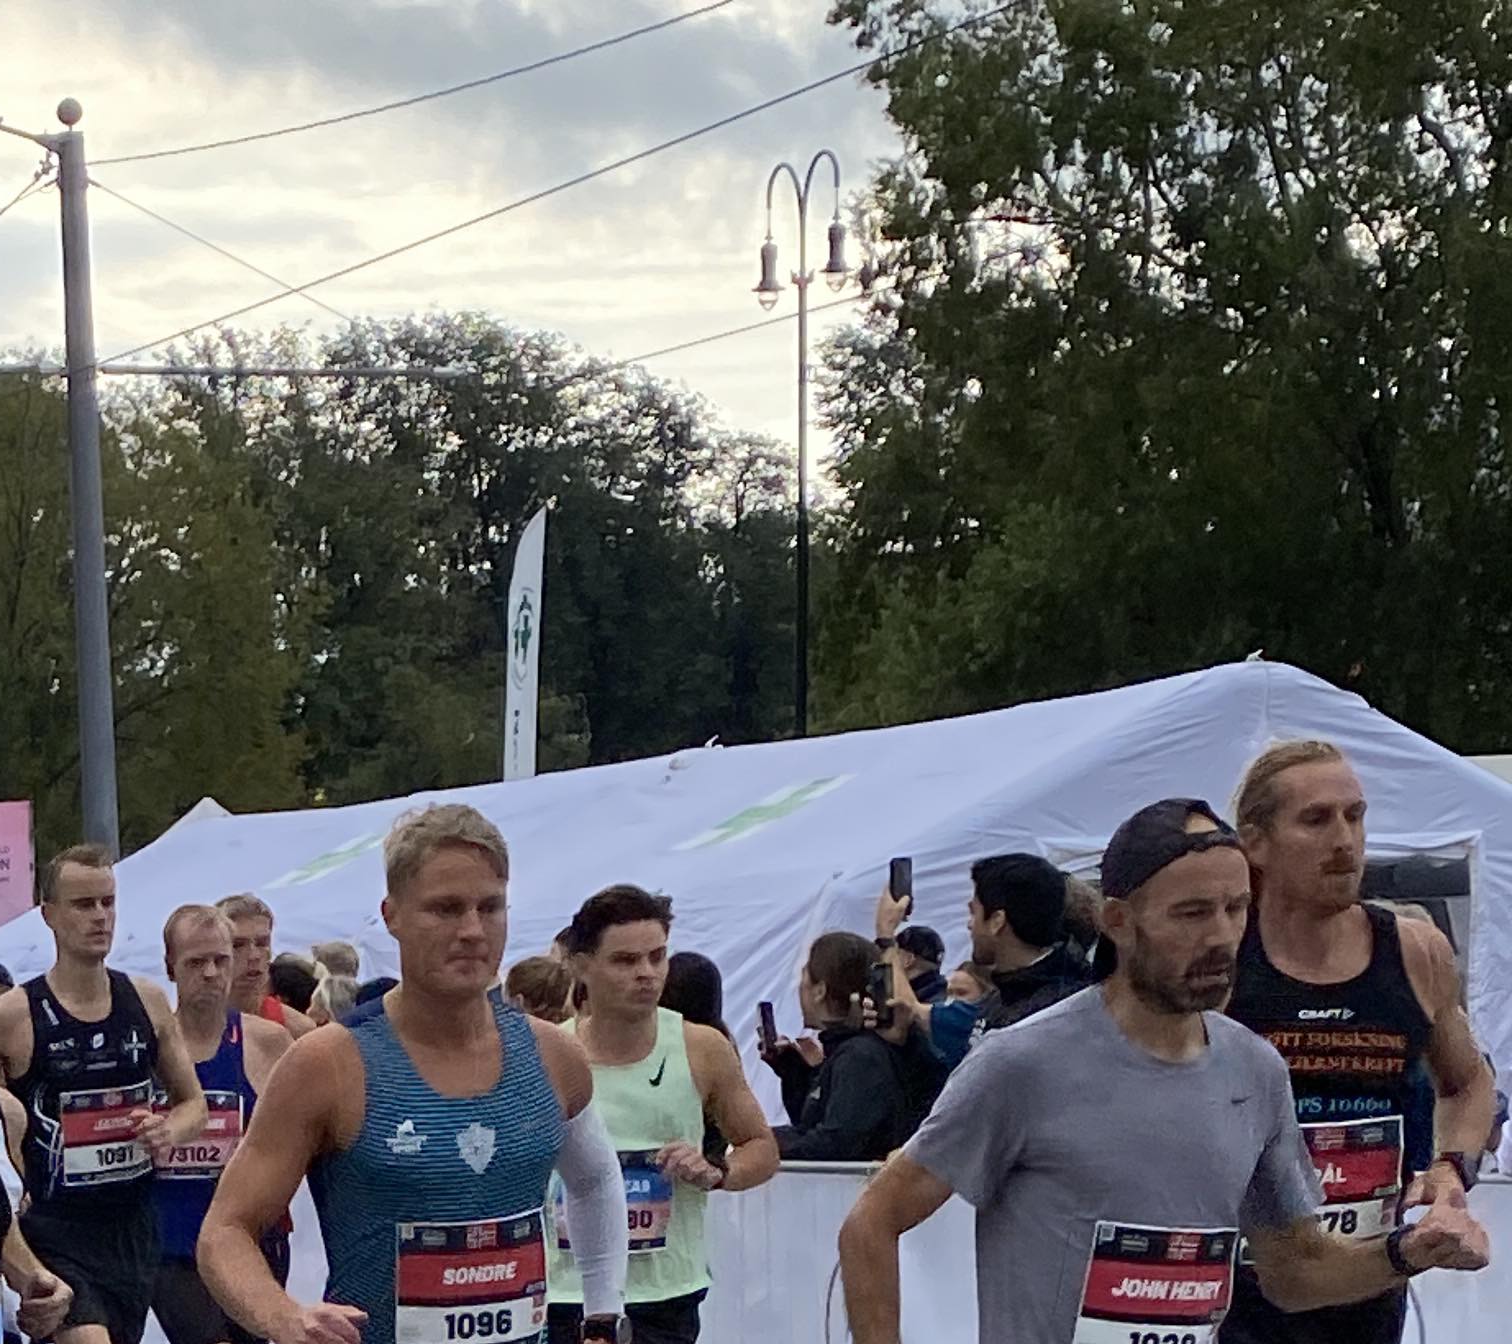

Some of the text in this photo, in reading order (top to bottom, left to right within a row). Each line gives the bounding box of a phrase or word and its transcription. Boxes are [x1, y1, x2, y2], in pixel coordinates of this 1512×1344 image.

[1316, 1208, 1358, 1233] 78
[443, 1261, 517, 1285] SONDRE
[1111, 1278, 1223, 1300] JOHN HENRY
[444, 1309, 513, 1340] 1096
